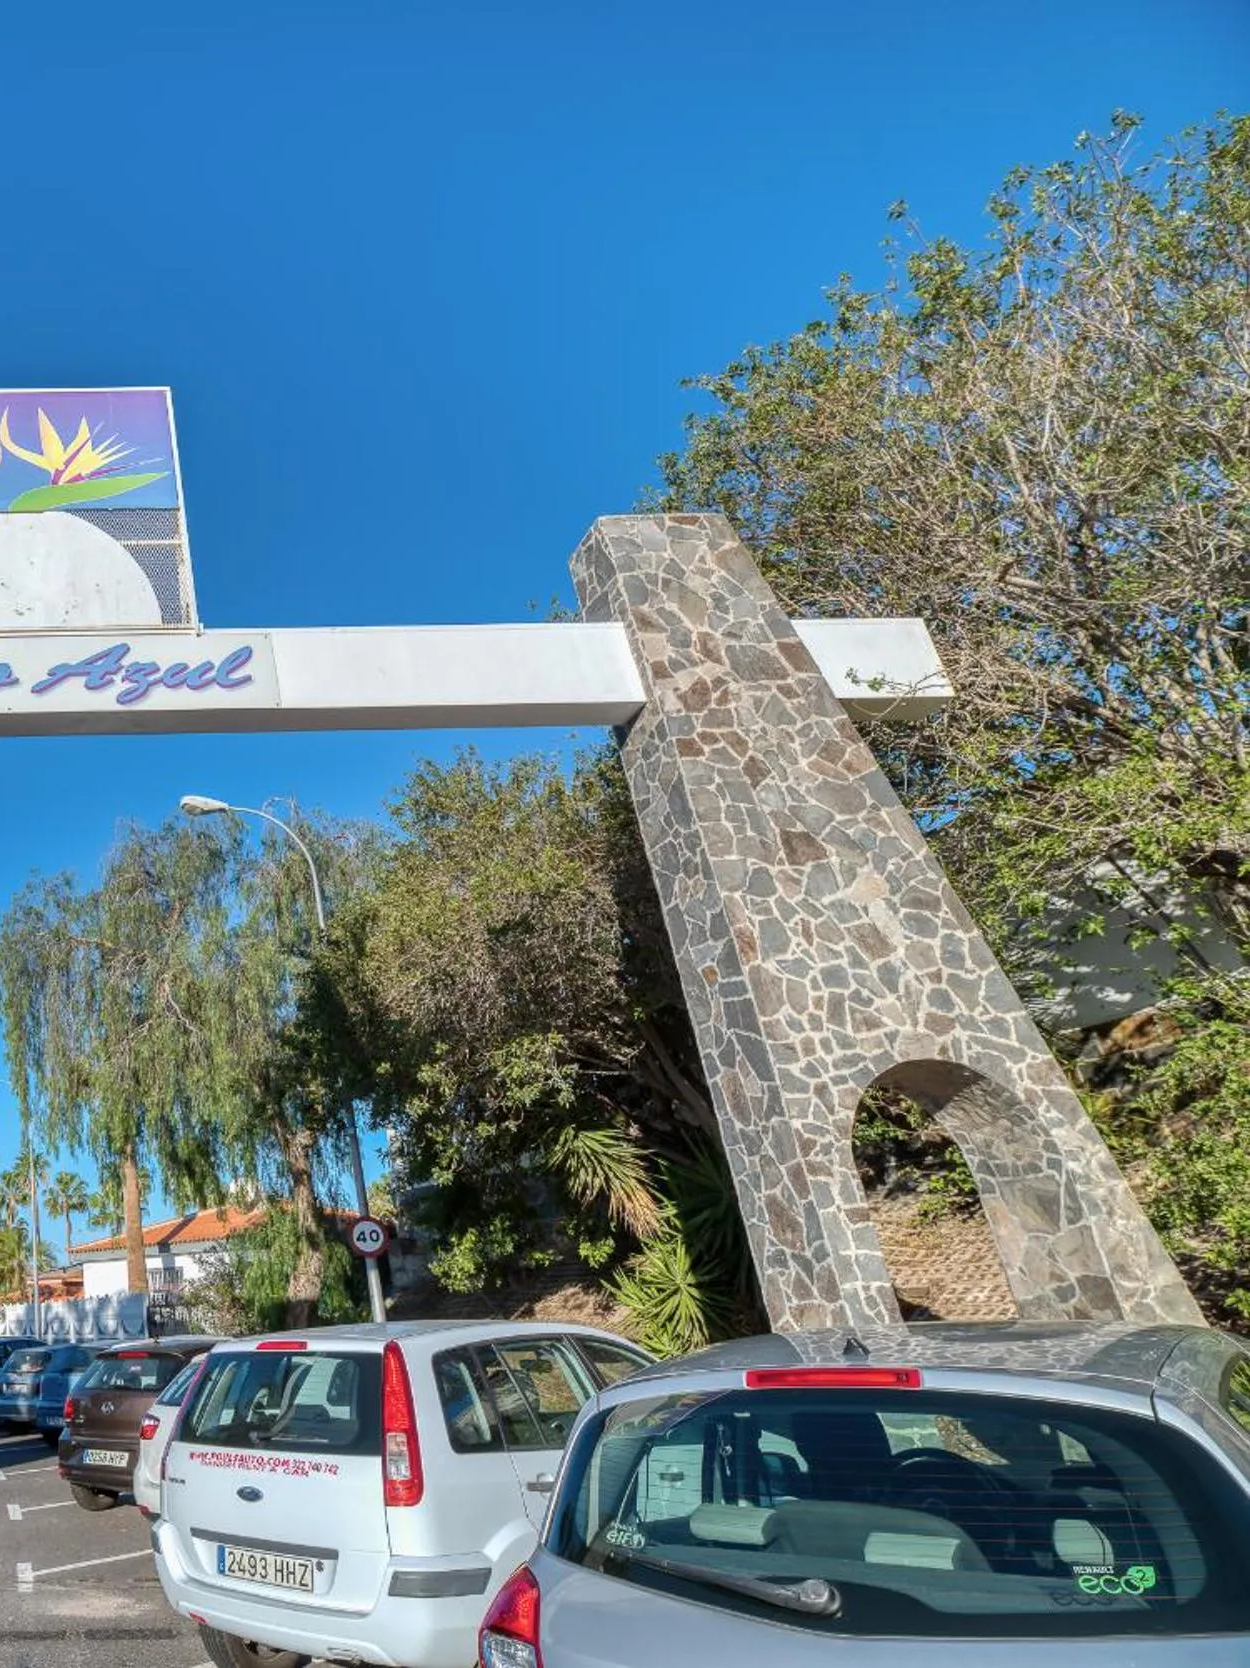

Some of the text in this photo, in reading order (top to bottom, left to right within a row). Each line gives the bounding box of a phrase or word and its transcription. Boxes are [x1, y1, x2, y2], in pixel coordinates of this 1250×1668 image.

[31, 642, 254, 704] Azul
[356, 1229, 380, 1243] 40
[227, 1551, 269, 1579] 2493
[274, 1558, 310, 1587] HHZ
